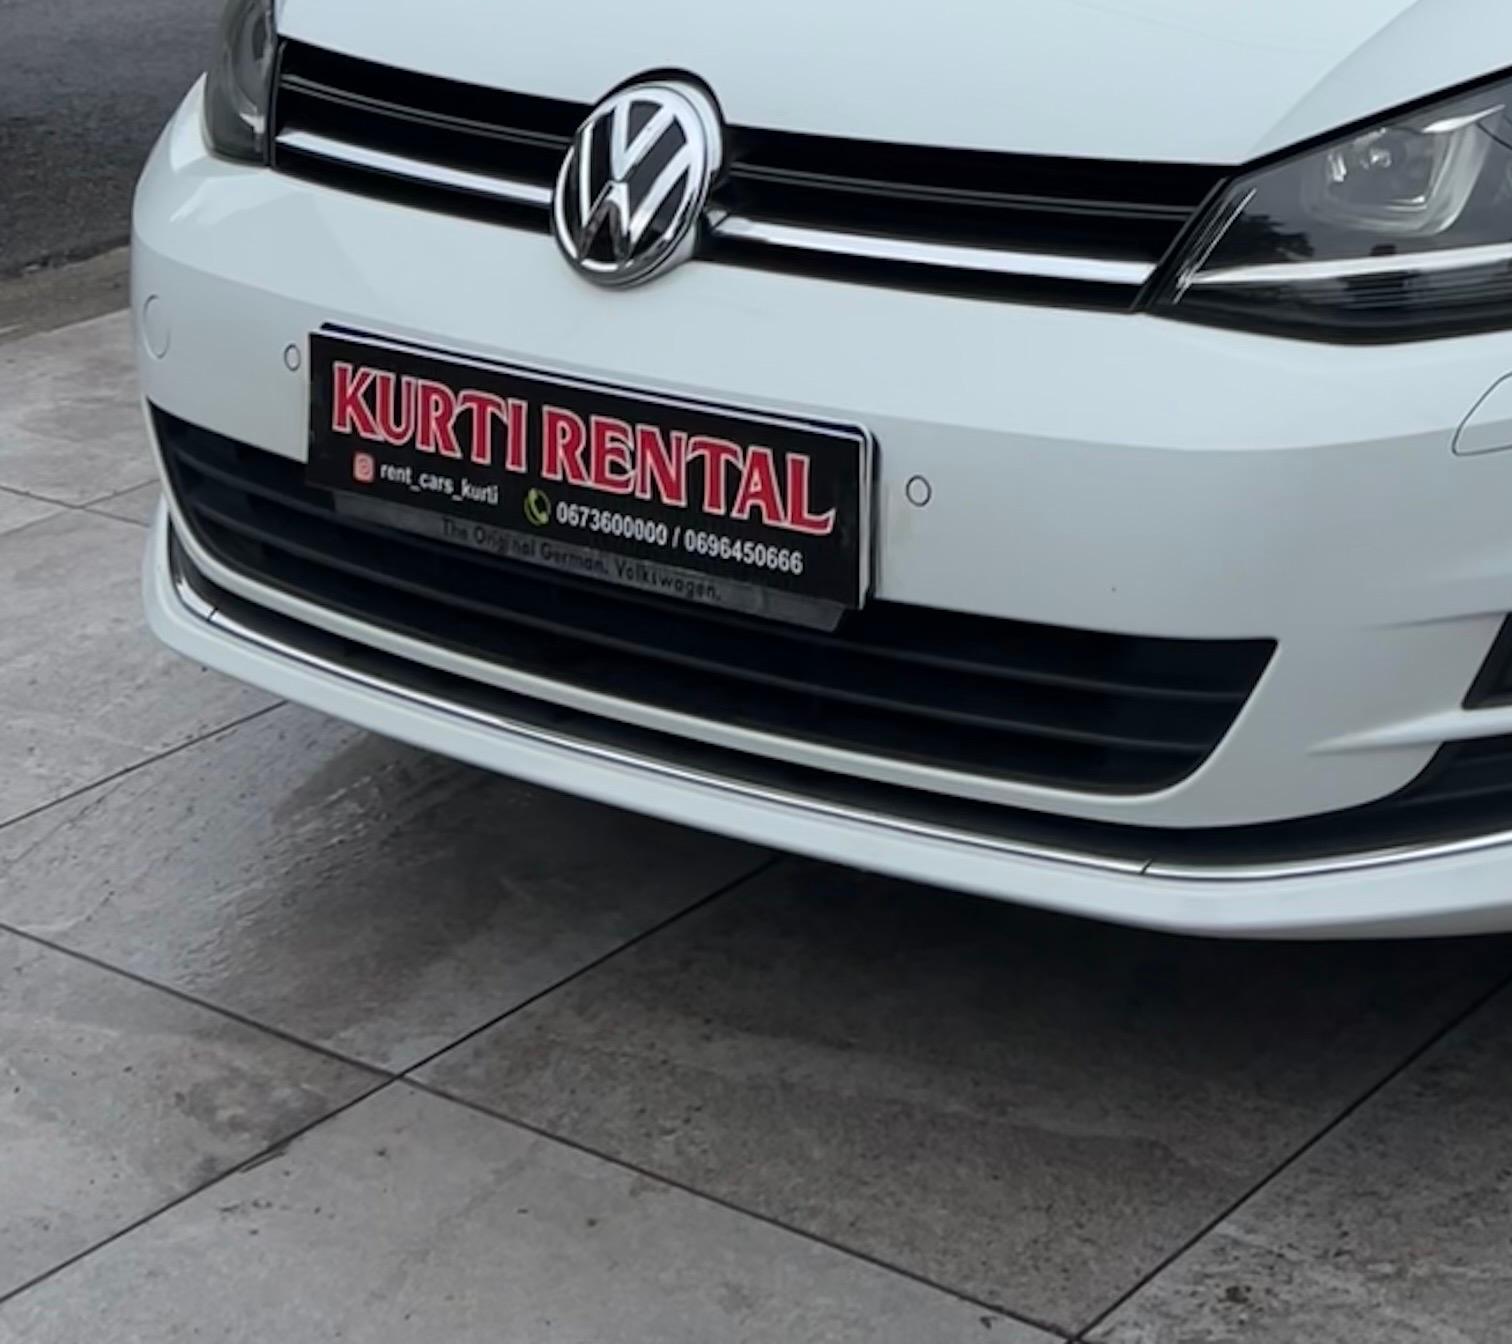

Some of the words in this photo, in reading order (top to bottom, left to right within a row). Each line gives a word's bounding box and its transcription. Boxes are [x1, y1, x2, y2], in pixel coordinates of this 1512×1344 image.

[332, 361, 528, 473] KURTI
[541, 404, 837, 536] RENTAL
[380, 461, 499, 505] rent_cars_kurti
[555, 500, 668, 546] 0673600000
[683, 529, 803, 575] 0696450666
